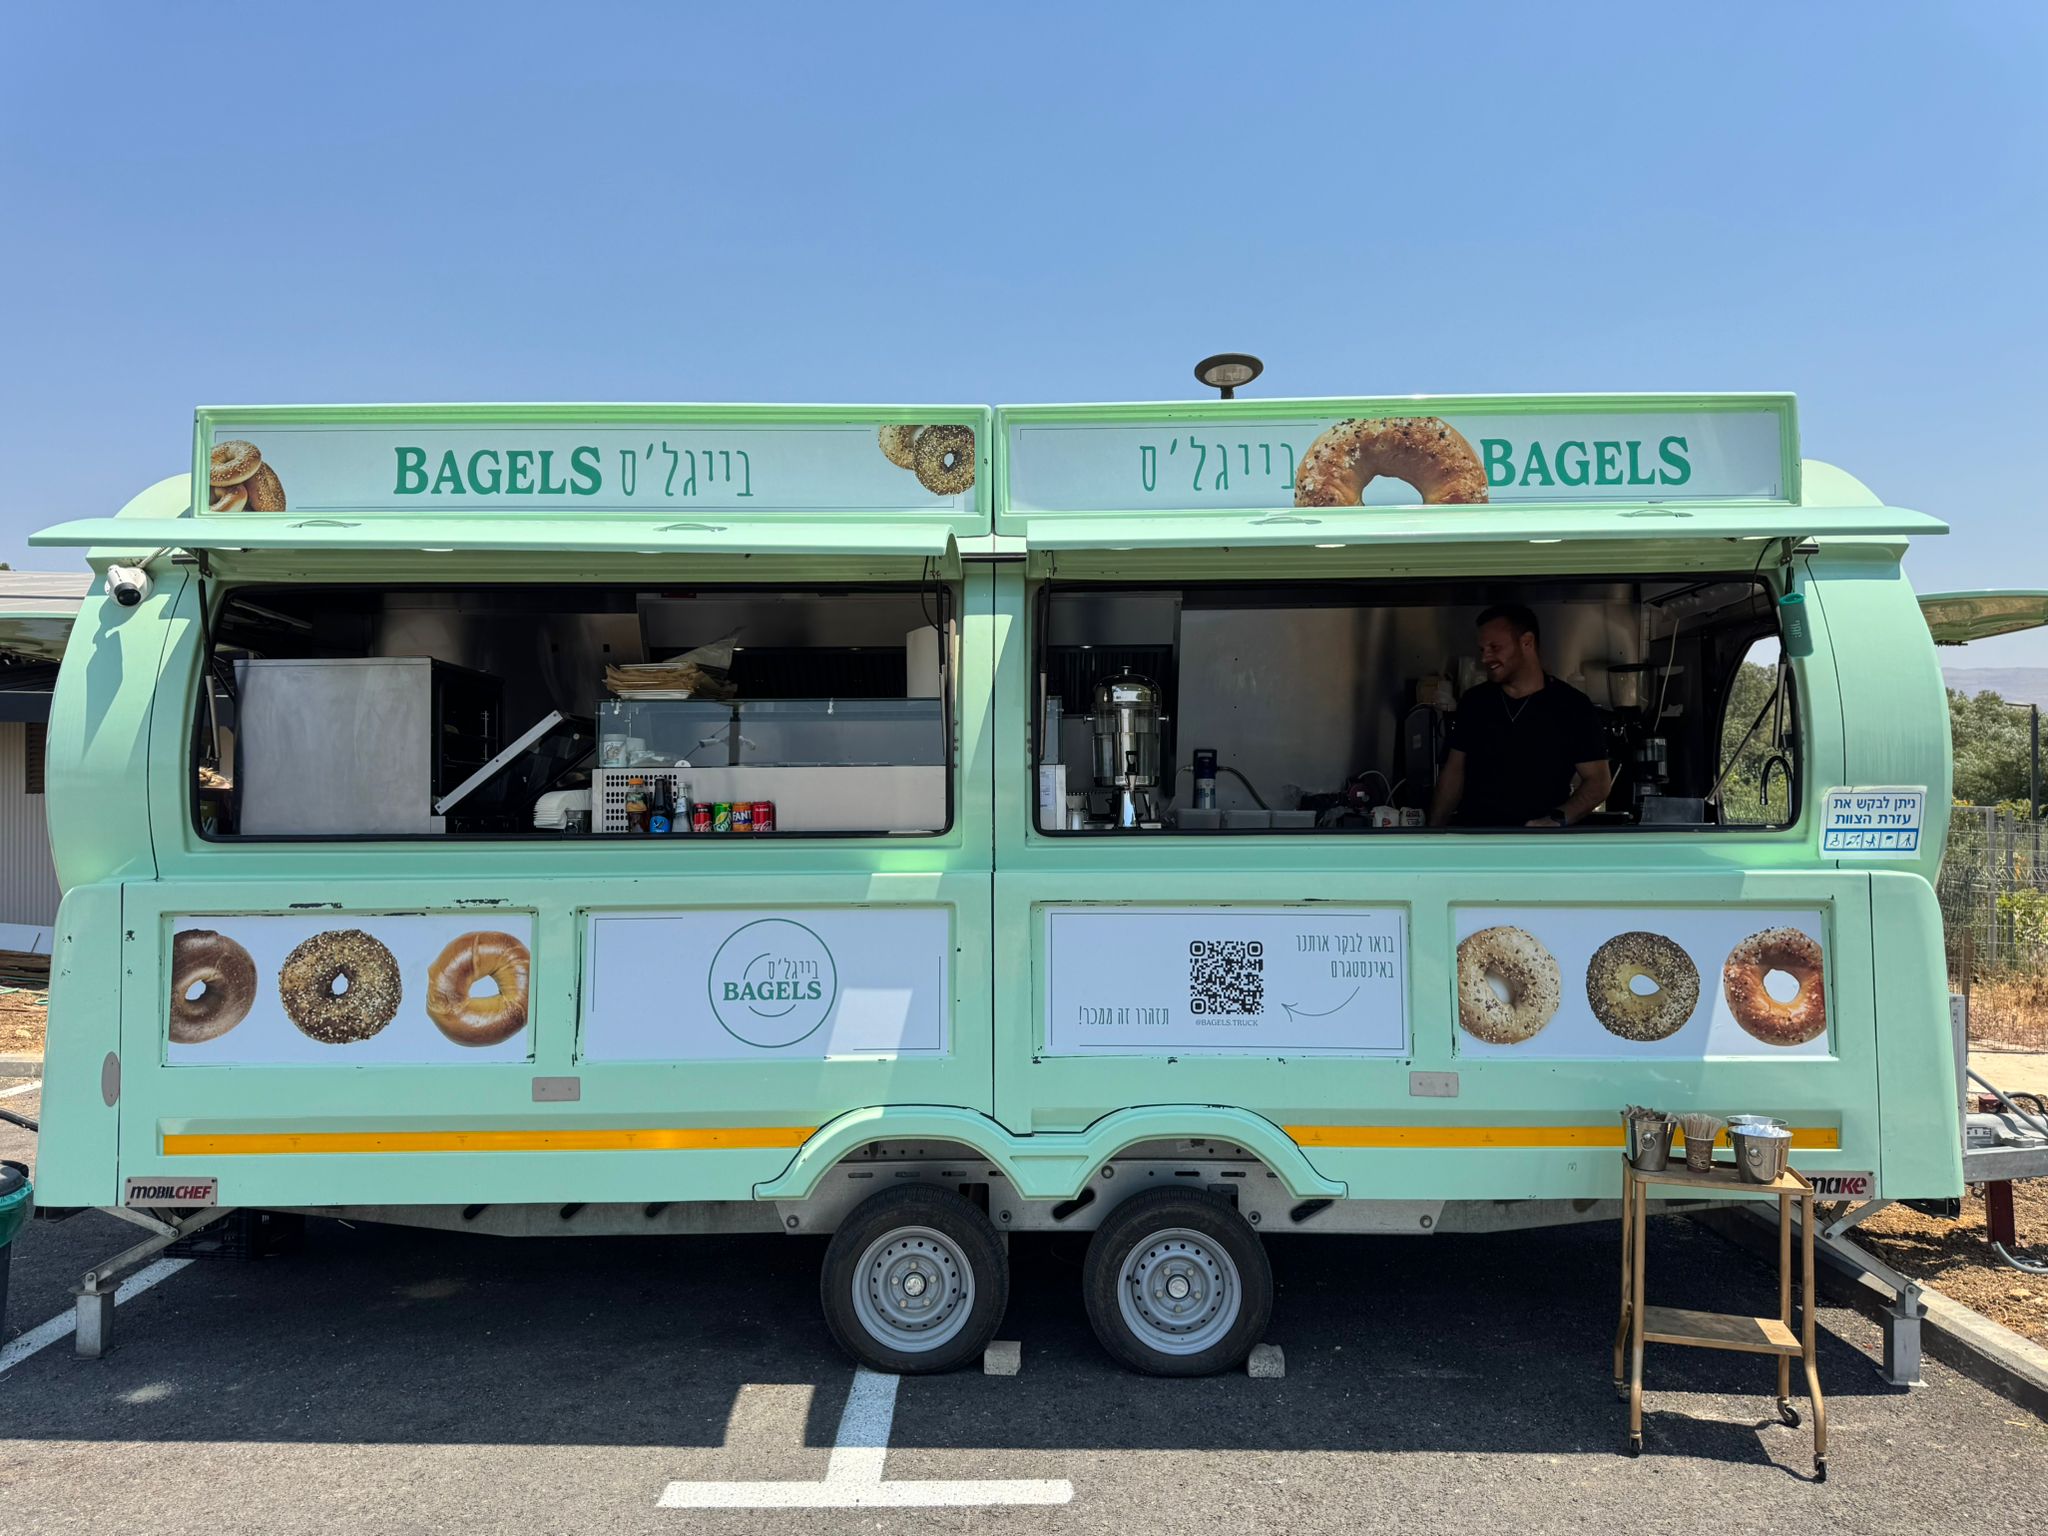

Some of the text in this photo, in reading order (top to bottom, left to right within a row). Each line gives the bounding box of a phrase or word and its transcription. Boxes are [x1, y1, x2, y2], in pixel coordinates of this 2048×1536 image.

[1480, 436, 1692, 486] BAGELS
[393, 446, 602, 496] BAGELS
[1833, 796, 1916, 811] ניתן לבקש את
[1835, 814, 1911, 825] עזרת הצוות
[1296, 932, 1394, 955] בואו לבקר אותנו
[1331, 961, 1394, 978] באינסטגרם
[723, 981, 822, 1001] BAGELS
[1078, 1006, 1169, 1025] תזהרו זה ממכר!
[1195, 1018, 1259, 1027] @BAGELS.TRUCK
